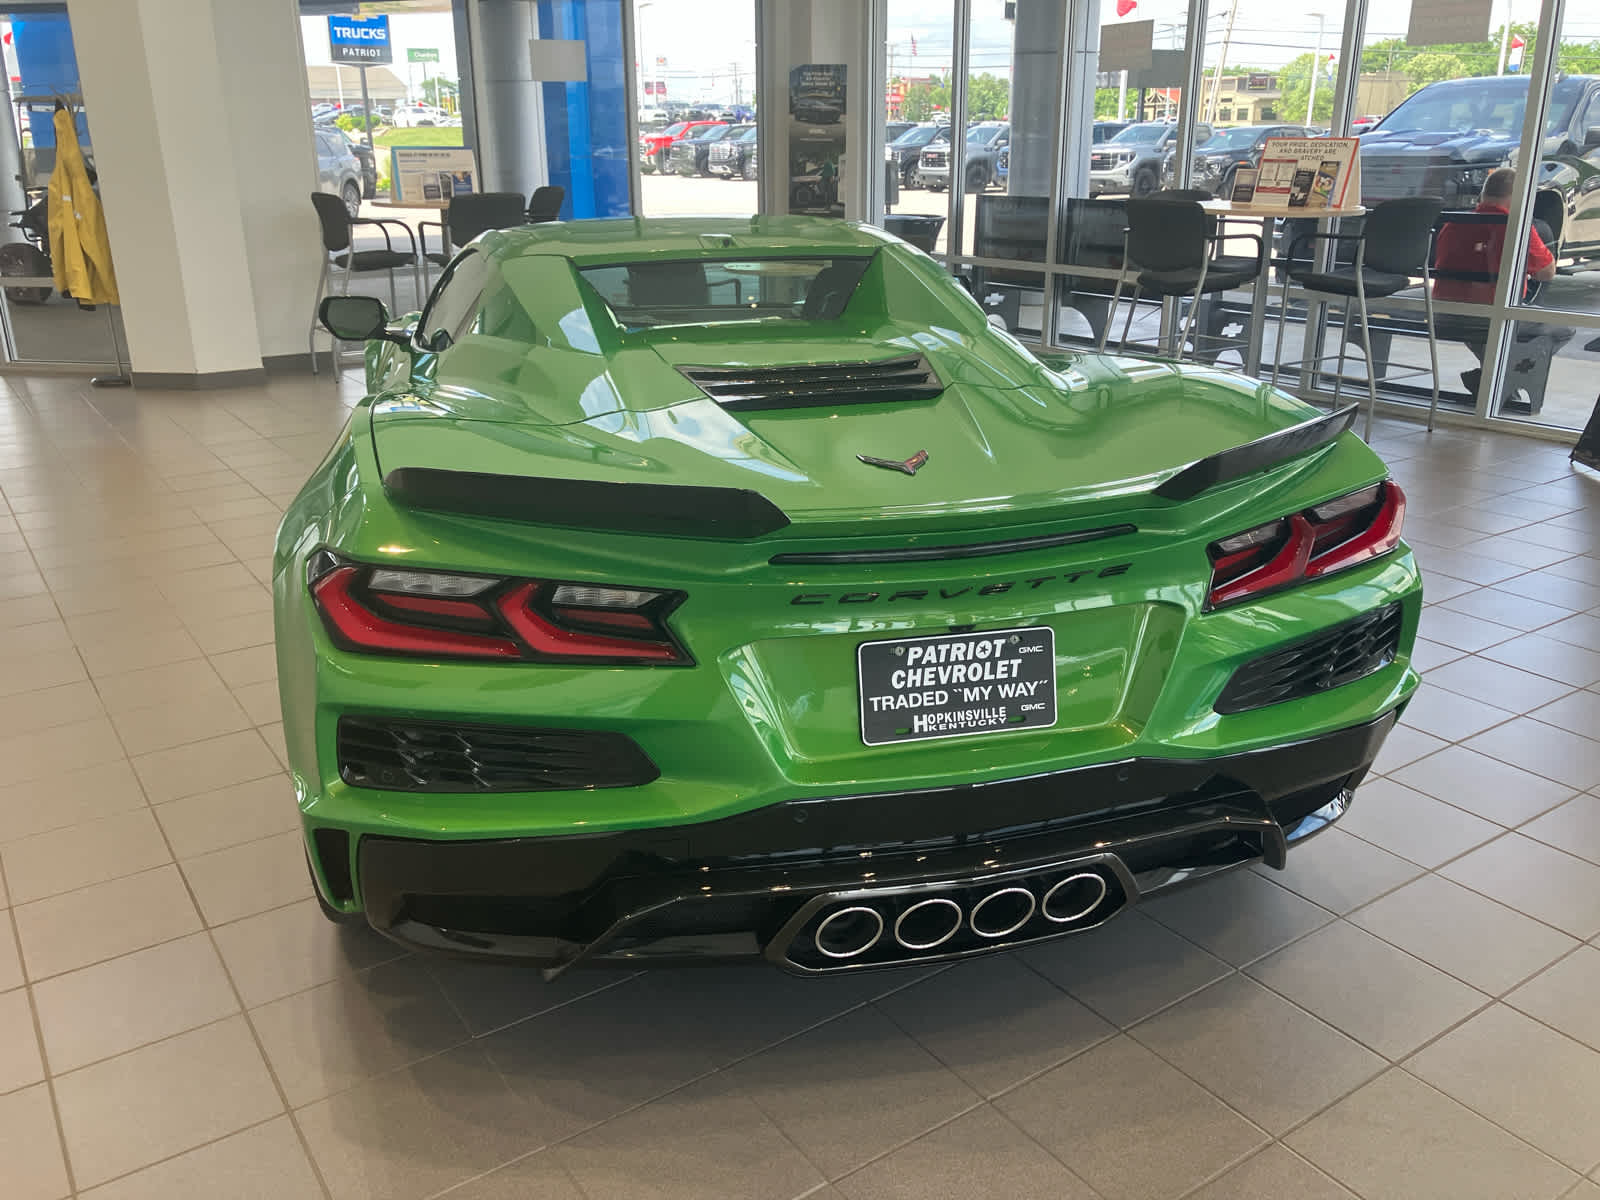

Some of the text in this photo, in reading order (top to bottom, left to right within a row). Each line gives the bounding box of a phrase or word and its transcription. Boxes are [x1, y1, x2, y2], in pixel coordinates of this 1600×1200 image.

[333, 26, 386, 40] TRUCKS
[342, 47, 381, 57] PATRIOT
[789, 562, 1134, 606] CORVETTE
[907, 638, 1007, 666] PATRIOT
[1018, 645, 1044, 654] GMC
[891, 658, 1022, 690] CHEVROLET
[869, 690, 949, 712] TRADED
[1020, 702, 1046, 712] GMC
[913, 706, 1007, 734] HOPKINSVILLE
[927, 717, 1007, 732] KENTUCKY
